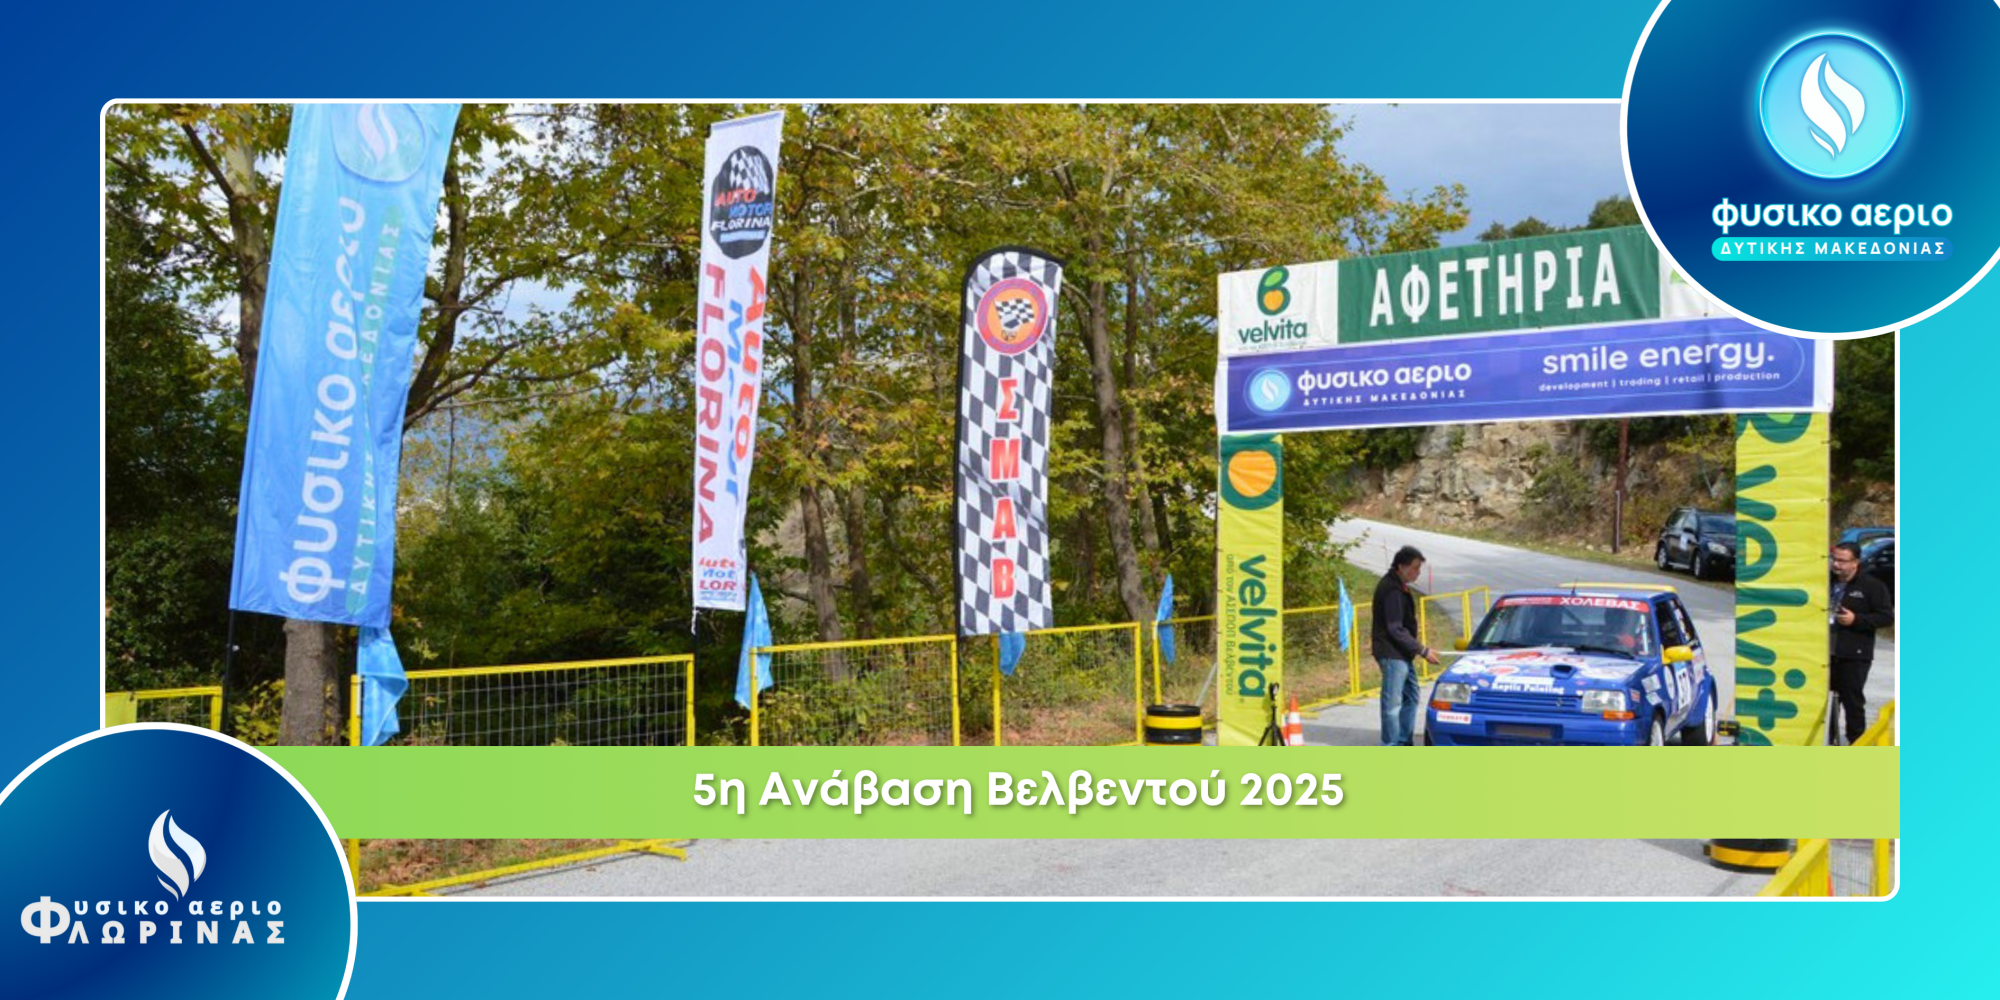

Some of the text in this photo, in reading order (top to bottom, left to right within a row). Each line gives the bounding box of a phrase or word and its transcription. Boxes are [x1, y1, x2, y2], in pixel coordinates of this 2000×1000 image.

[714, 188, 757, 207] AUTO
[729, 202, 773, 218] MOTOR
[711, 216, 771, 231] FLORINA
[1369, 243, 1621, 327] ΑΦΕΤΗΡΙΑ
[1238, 318, 1308, 344] velvita
[1543, 342, 1774, 374] smile energy.
[1297, 363, 1472, 396] φυσικο αεριο
[1538, 380, 1609, 392] development
[1619, 376, 1661, 387] trading
[1672, 374, 1705, 384] retail
[1714, 371, 1780, 382] production
[698, 262, 726, 544] FLORINA
[1303, 389, 1466, 406] ΔΥΤΙΚΗΣ ΜΑΚΕΔΟΝΙΑΣ
[1560, 597, 1642, 611] ΧΟΛΕΒΑΣ
[1238, 554, 1278, 697] velvita
